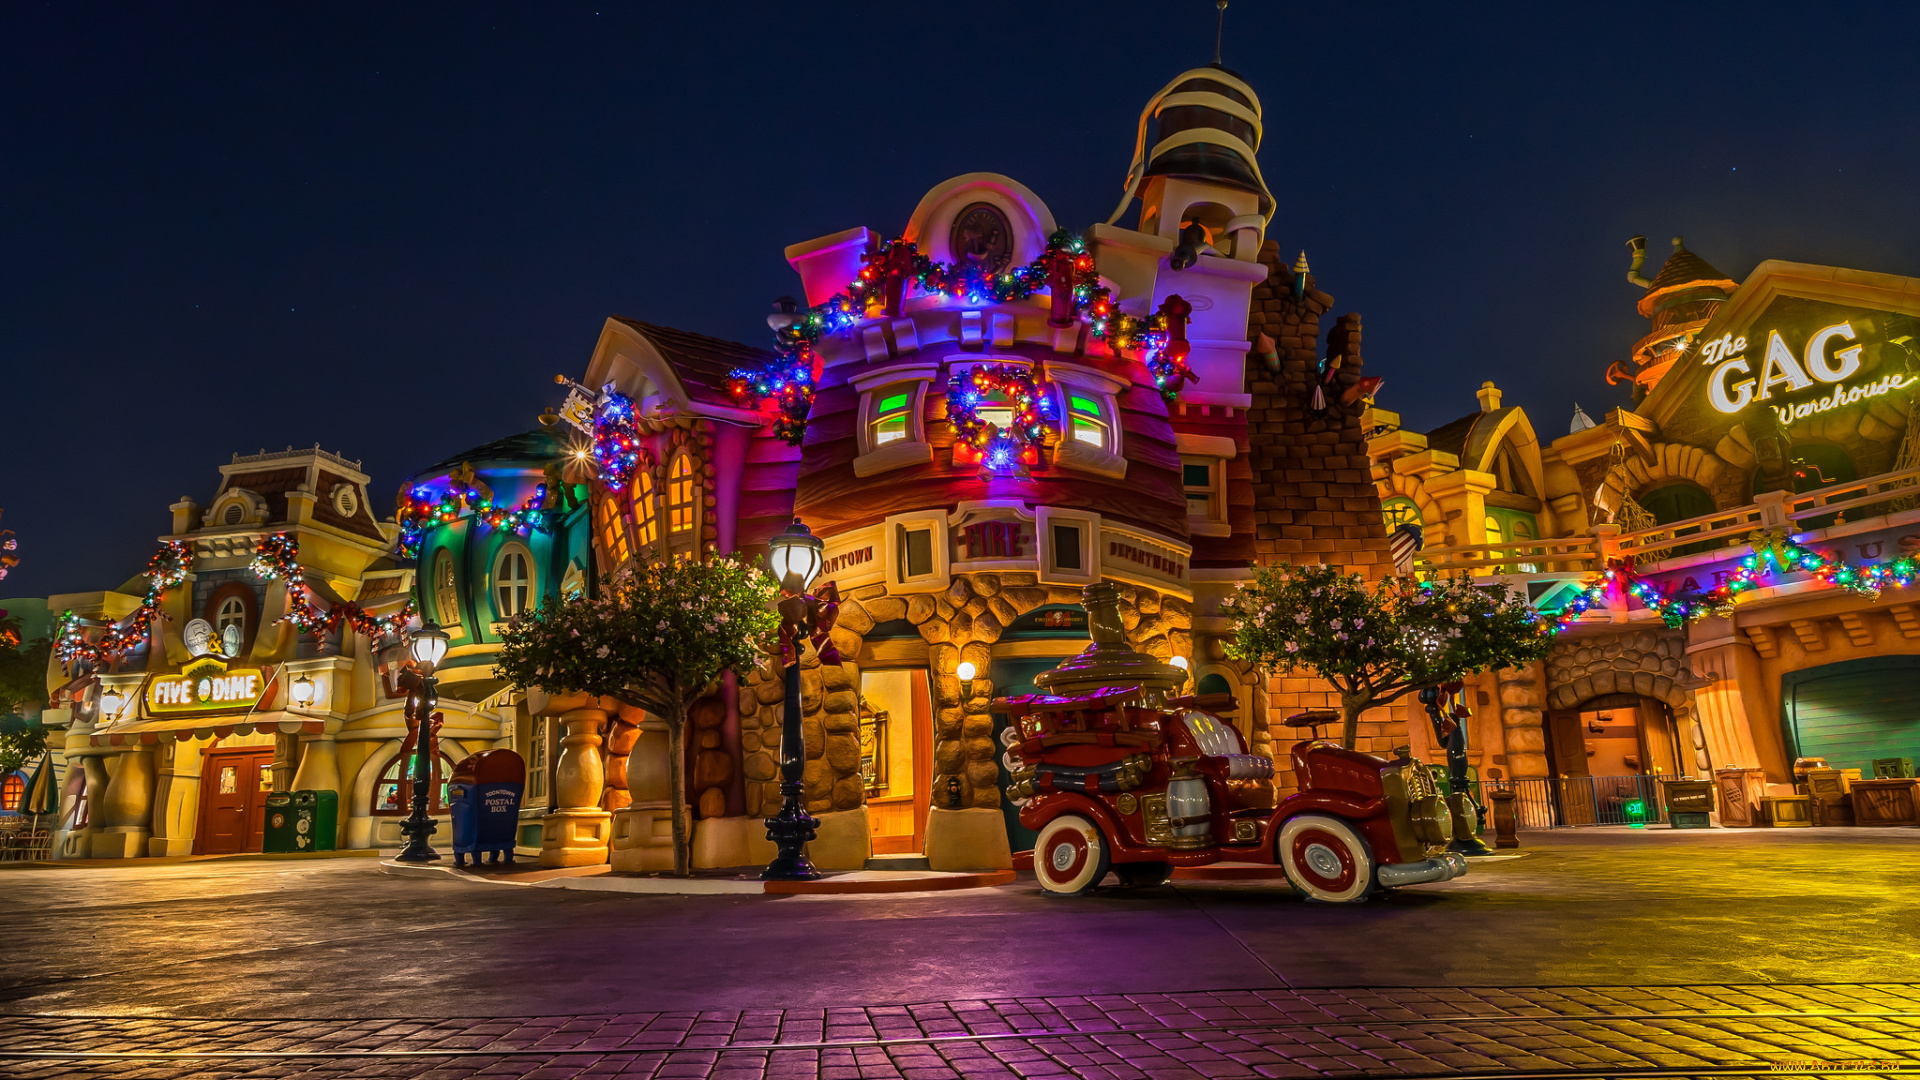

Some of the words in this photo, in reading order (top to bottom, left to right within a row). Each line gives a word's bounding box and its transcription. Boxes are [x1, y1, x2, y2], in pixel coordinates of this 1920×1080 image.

[1702, 332, 1748, 365] The
[1707, 320, 1862, 413] GAG
[1769, 374, 1919, 425] Warehouse
[963, 520, 1023, 558] FIRE
[817, 545, 873, 578] ONTOWN
[1110, 541, 1184, 580] DEPARTMENT
[207, 632, 223, 654] &
[154, 680, 192, 704] FIVE
[212, 675, 257, 701] DIME
[485, 789, 516, 797] TOONTOWN
[485, 798, 514, 806] POSTAL
